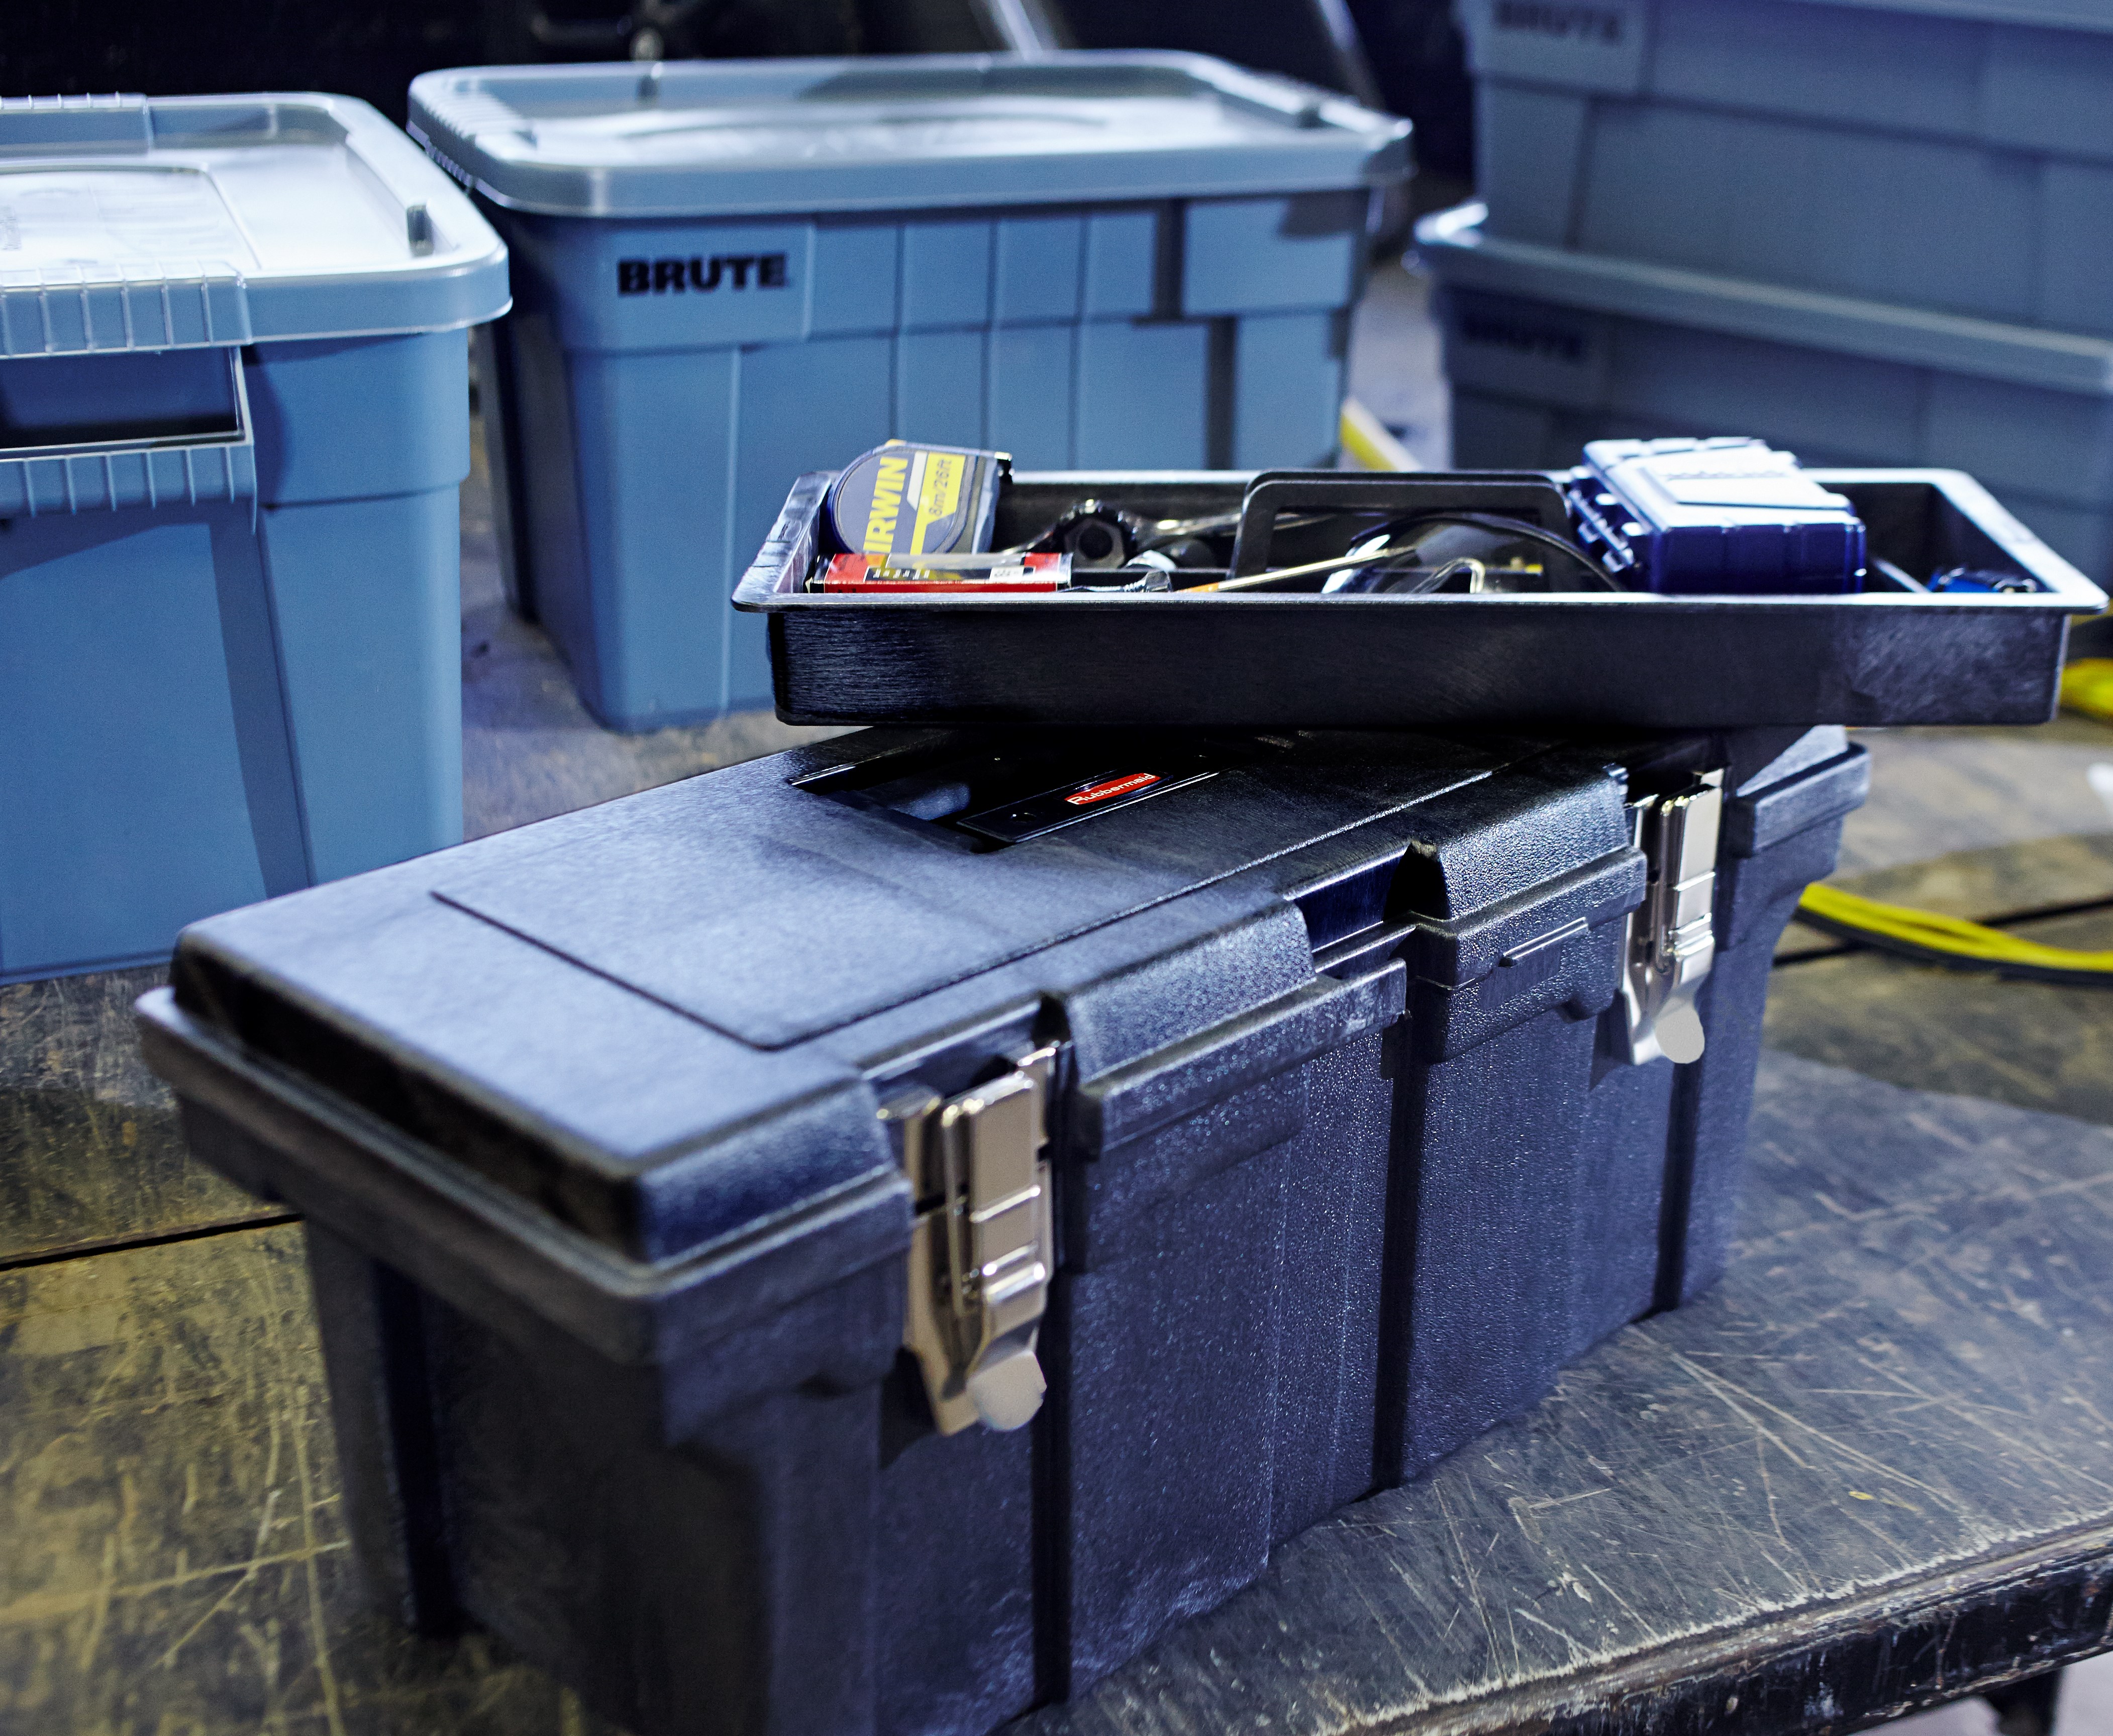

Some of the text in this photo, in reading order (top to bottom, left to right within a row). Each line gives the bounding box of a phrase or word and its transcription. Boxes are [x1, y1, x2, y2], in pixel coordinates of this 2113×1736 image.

[618, 252, 788, 296] BRUTE
[863, 457, 909, 553] IRWIN
[929, 458, 952, 517] 8m/26ft
[1067, 773, 1156, 805] Rubbermaid
